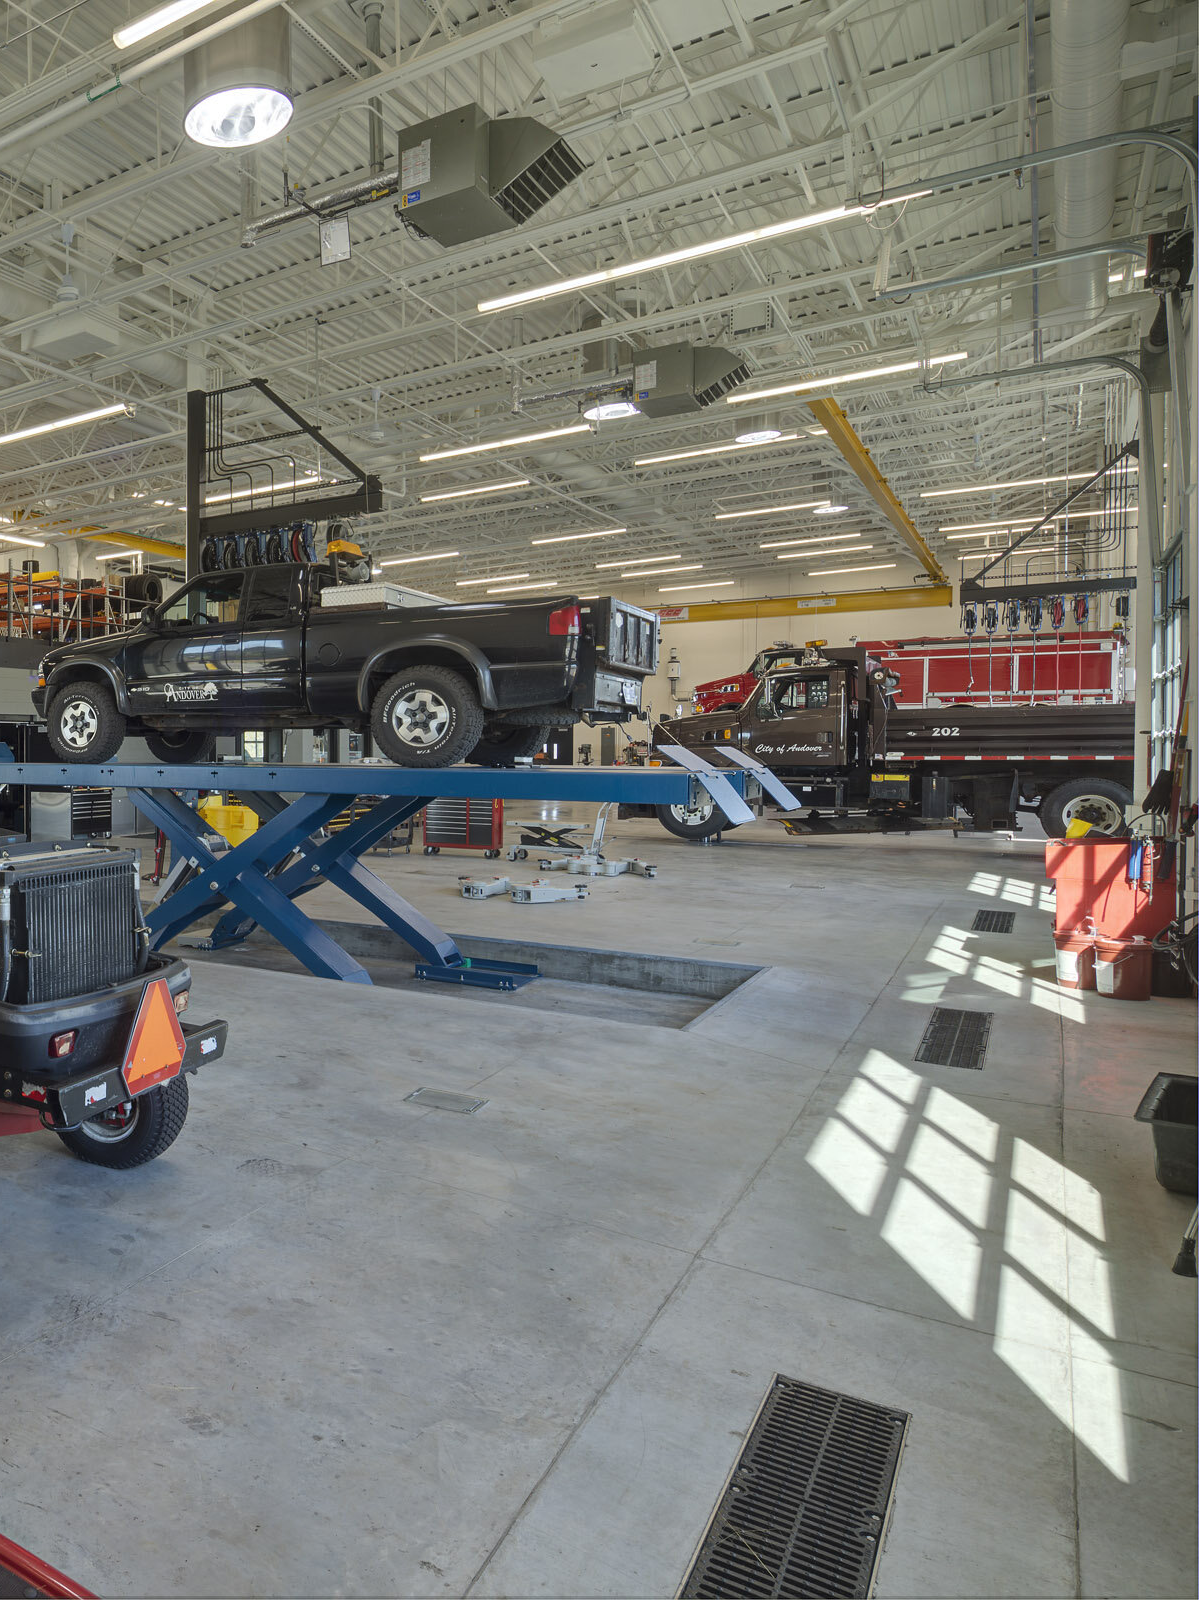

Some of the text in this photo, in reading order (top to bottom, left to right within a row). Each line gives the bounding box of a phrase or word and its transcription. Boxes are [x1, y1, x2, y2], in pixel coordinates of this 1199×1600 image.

[164, 683, 205, 702] ANDOVER
[383, 682, 416, 723] BFGoodrich
[931, 727, 960, 737] 202
[755, 743, 823, 754] City of Andover
